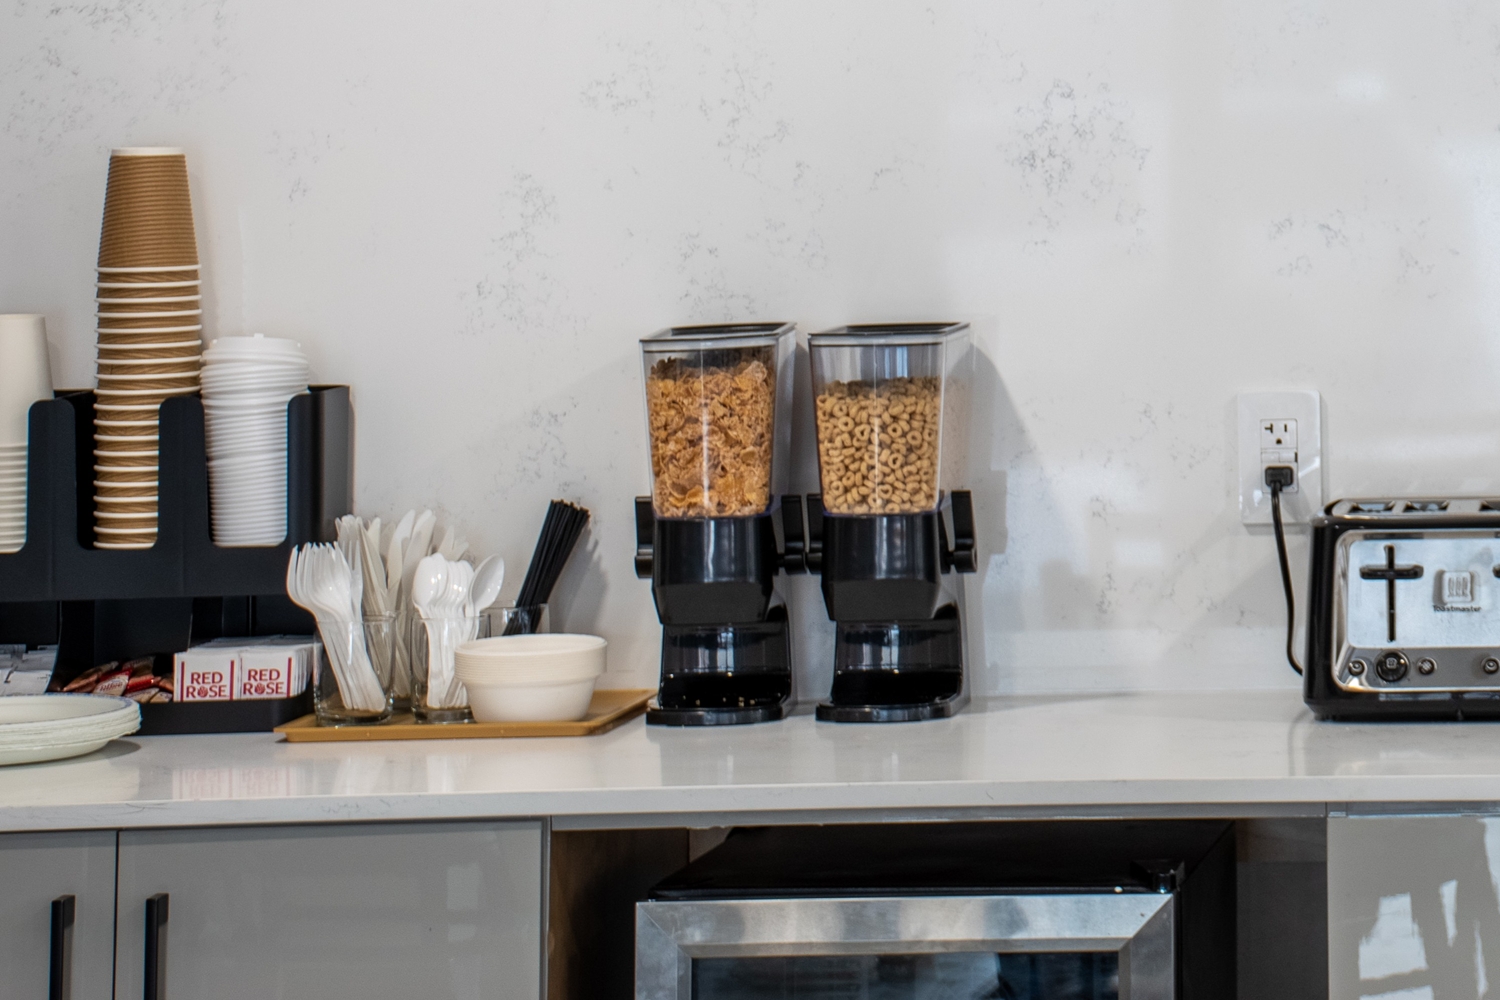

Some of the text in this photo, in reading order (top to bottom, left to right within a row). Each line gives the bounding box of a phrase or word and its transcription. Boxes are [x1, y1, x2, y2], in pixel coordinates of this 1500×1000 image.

[190, 671, 223, 685] RED
[247, 668, 281, 681] RED
[186, 685, 228, 699] ROSE
[243, 682, 285, 695] ROSE
